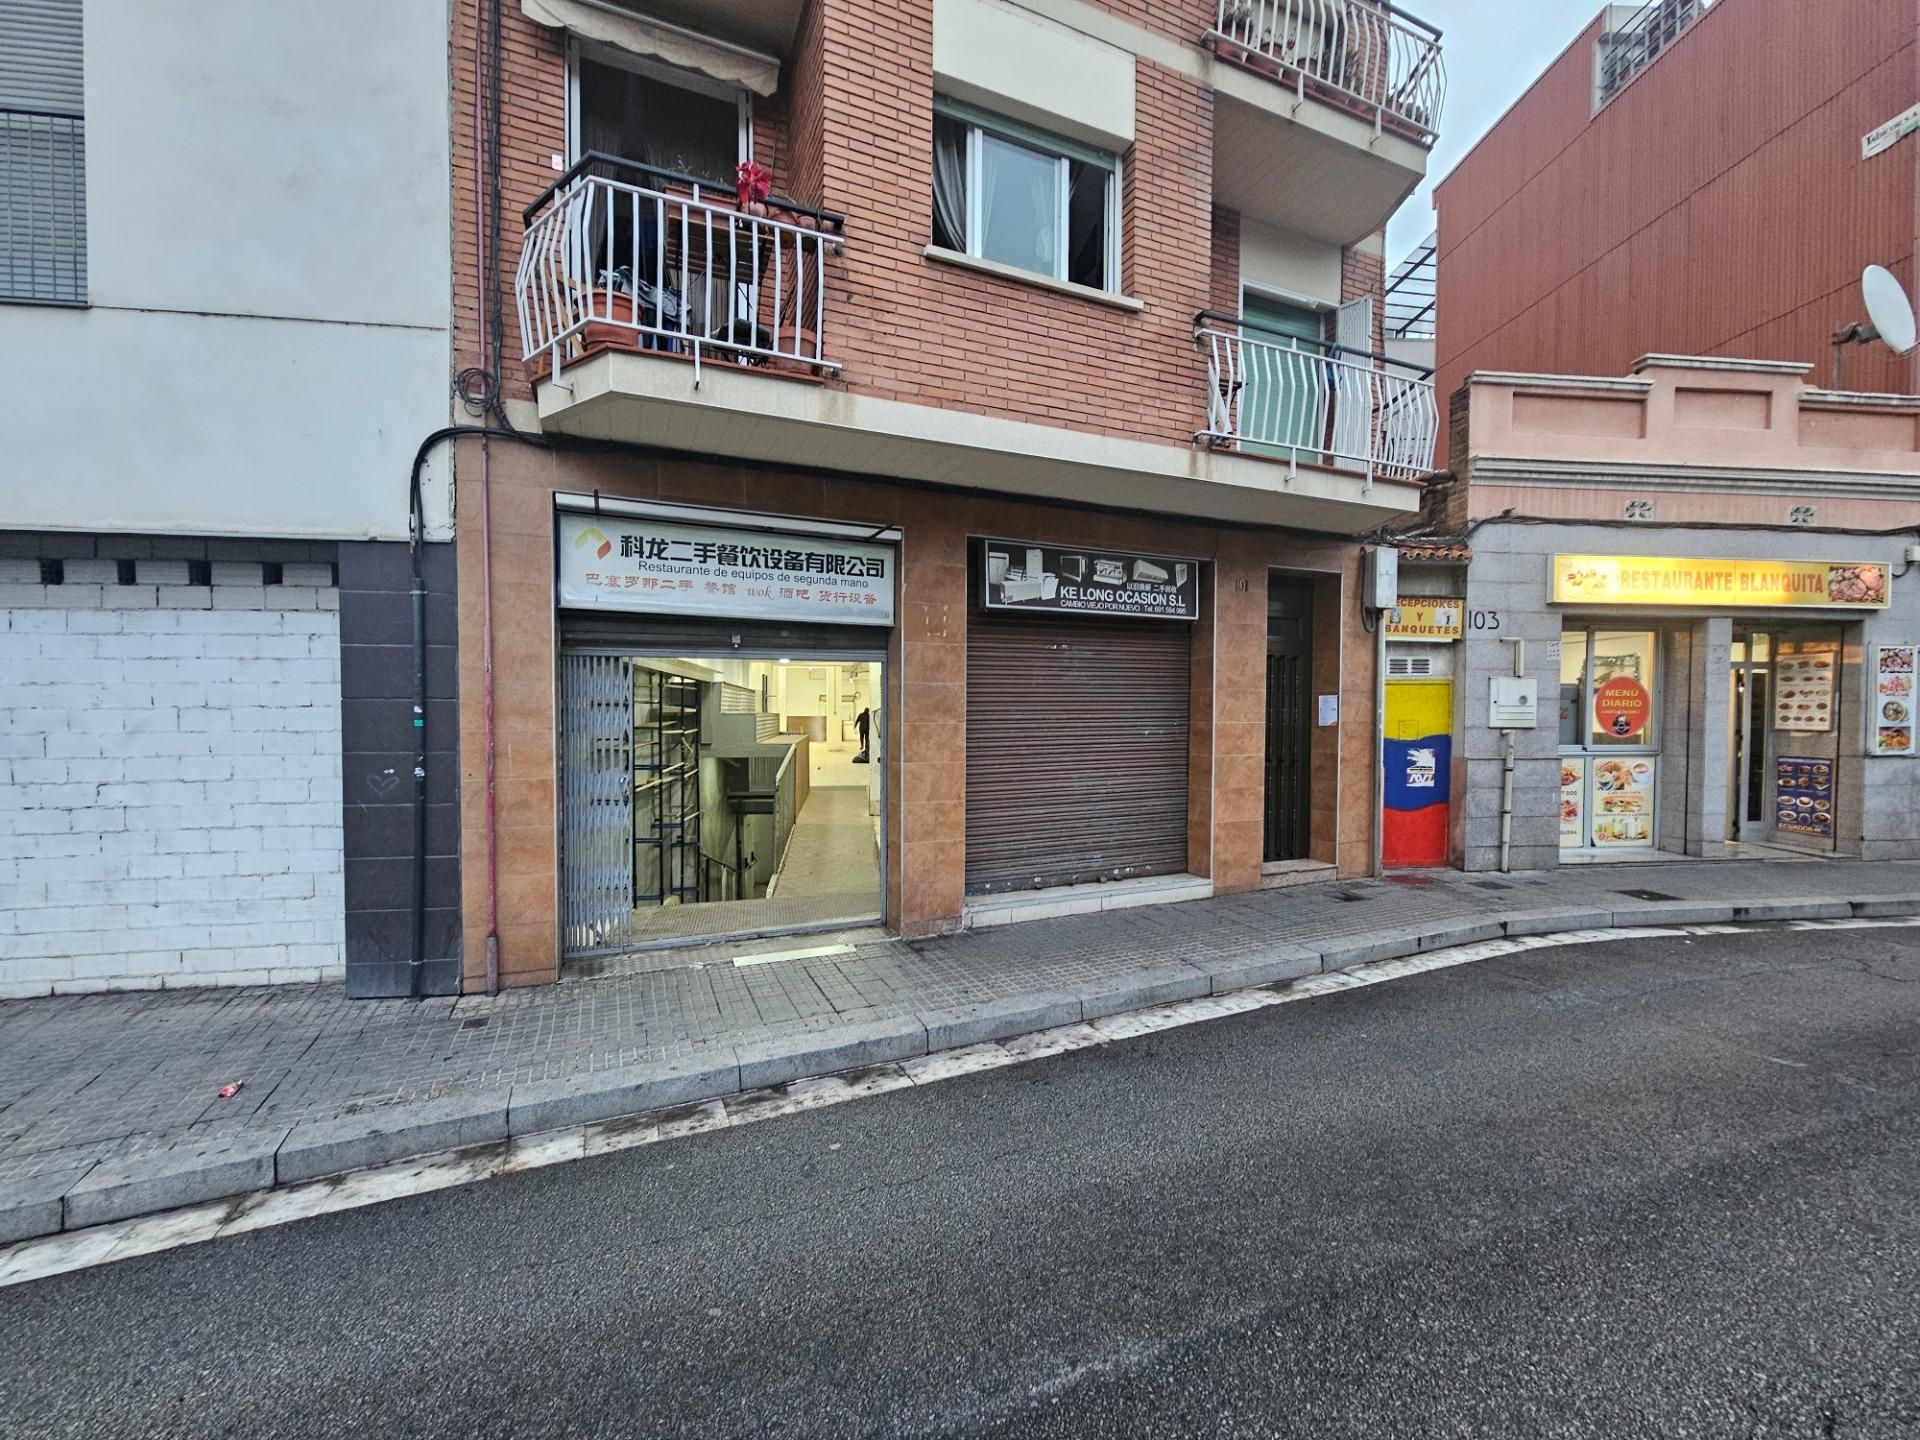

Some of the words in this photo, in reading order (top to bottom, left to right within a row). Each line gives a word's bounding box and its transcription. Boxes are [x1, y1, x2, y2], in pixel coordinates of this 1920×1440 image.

[621, 535, 884, 578] 科龙二手餐饮设备有限公司
[639, 561, 710, 576] Restaurante
[714, 567, 727, 577] de
[731, 570, 775, 582] equipos
[777, 572, 791, 583] de
[793, 576, 838, 587] segunda
[840, 579, 869, 588] mano
[1620, 569, 1733, 591] RESTAURANTE
[1740, 572, 1823, 593] BLANQUITA
[586, 574, 693, 591] 巴塞罗那二手
[747, 586, 775, 600] wok
[780, 587, 811, 600] 酒吧
[1060, 586, 1077, 600] KE
[1080, 588, 1114, 602] LONG
[1116, 591, 1167, 606] OCASION
[1060, 600, 1086, 608] CAMBIO
[1087, 601, 1105, 610] VIEJO
[1105, 602, 1119, 611] POR
[1119, 603, 1141, 612] NUEVO
[1396, 599, 1460, 609] ECEPCIONES
[1417, 612, 1423, 622] Y
[1468, 611, 1500, 630] 103
[1385, 624, 1460, 635] BANQUETES
[1605, 688, 1639, 697] MENÚ
[1602, 699, 1642, 708] DIARIO
